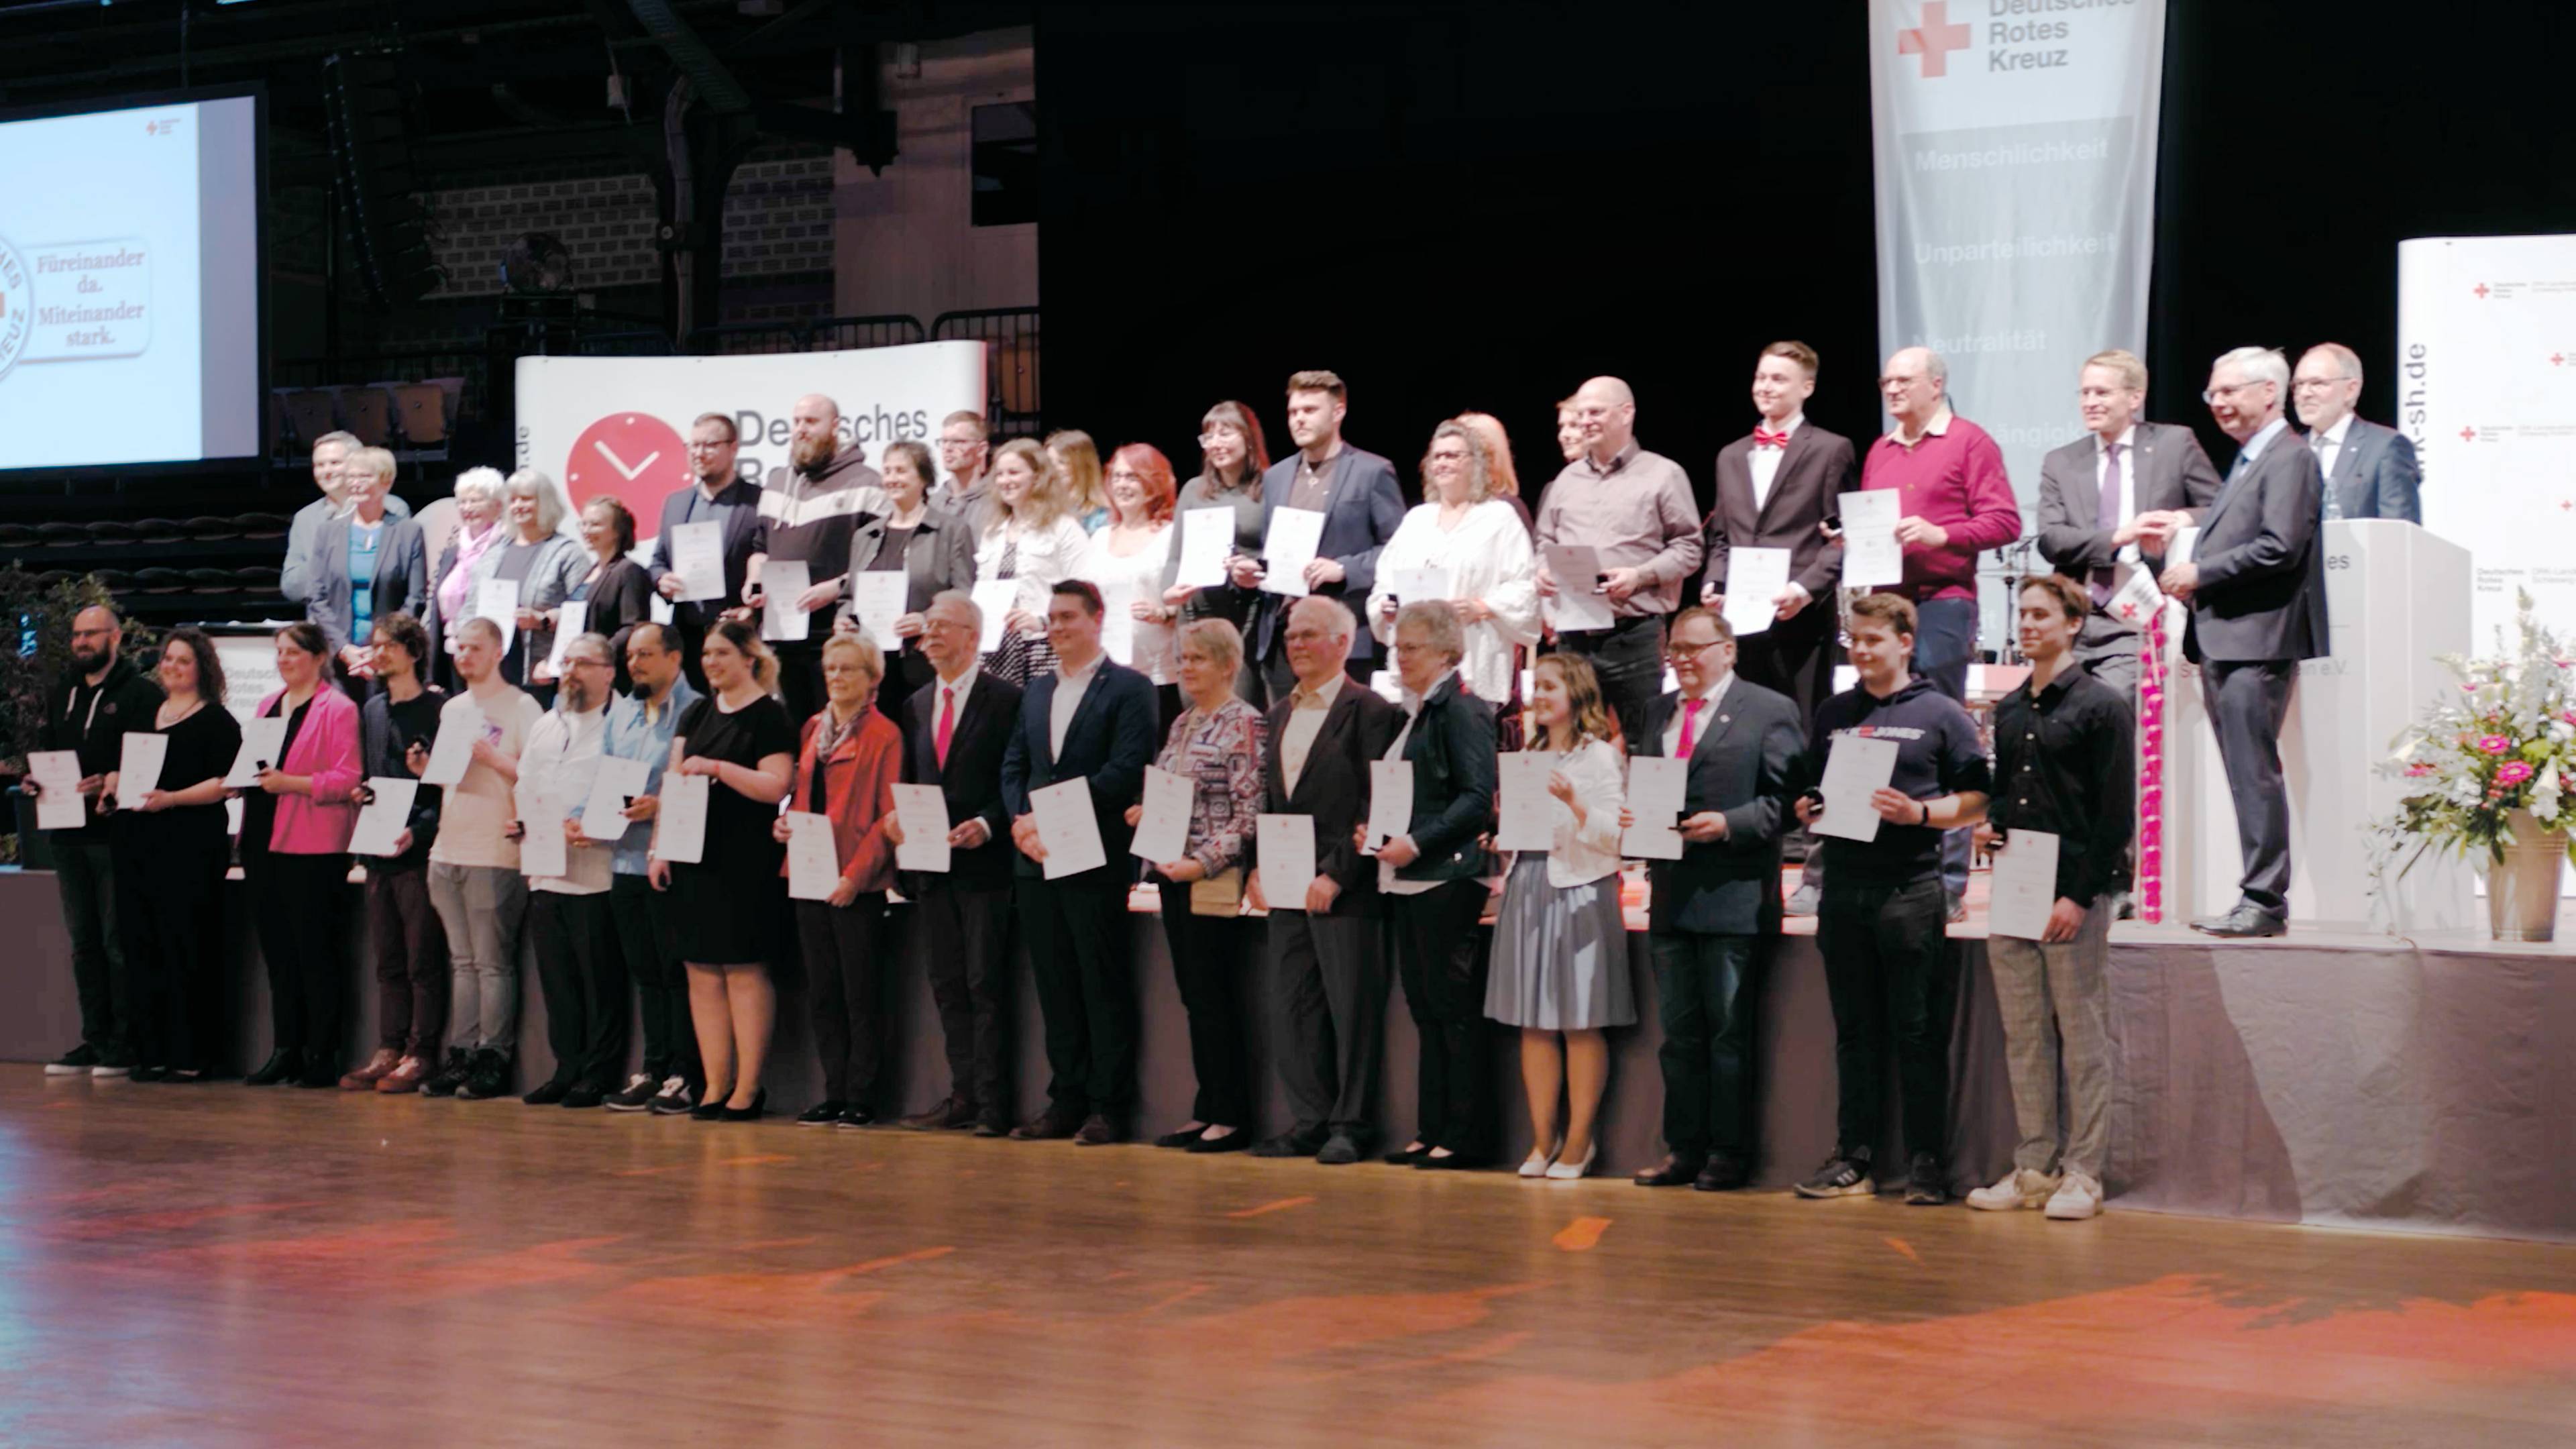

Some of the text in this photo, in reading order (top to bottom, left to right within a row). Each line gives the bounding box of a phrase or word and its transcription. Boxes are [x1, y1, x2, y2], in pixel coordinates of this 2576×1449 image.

[1988, 20, 2070, 45] Rotes
[1988, 49, 2069, 72] Kreuz
[1914, 136, 2110, 172] Menschlichkeit
[37, 248, 146, 274] Füreinander
[1914, 232, 2116, 267] Unparteilichkeit
[76, 274, 103, 294] da.
[38, 300, 145, 326] Miteinander
[66, 325, 116, 347] stark.
[736, 404, 928, 447] Desches
